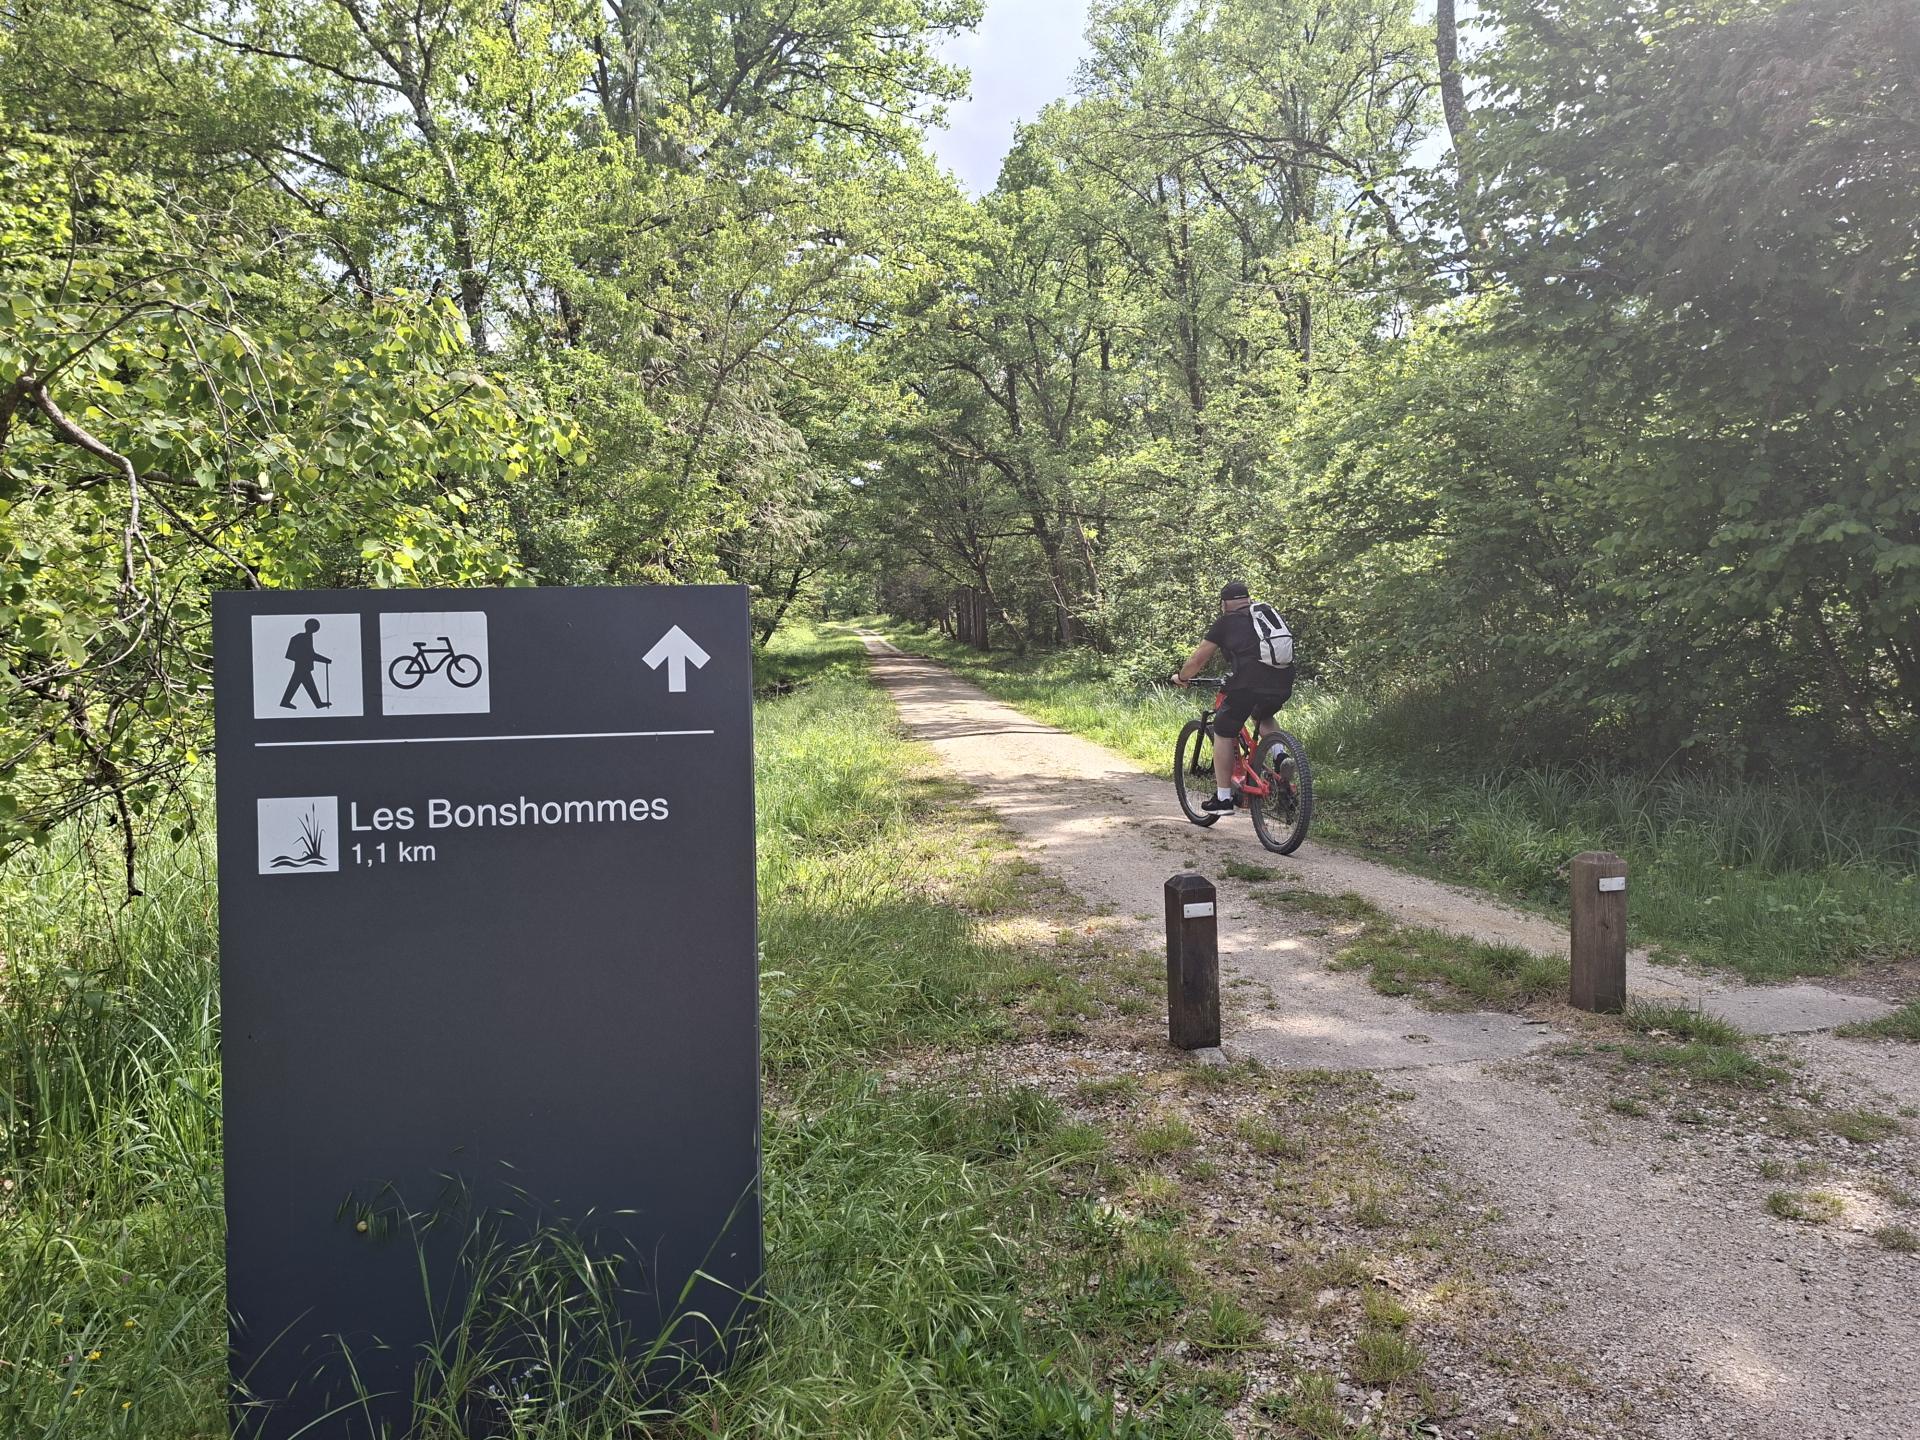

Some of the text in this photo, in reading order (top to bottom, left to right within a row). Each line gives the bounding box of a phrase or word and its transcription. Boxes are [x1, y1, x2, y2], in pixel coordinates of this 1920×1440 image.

[350, 795, 669, 831] Les Bonshommes
[351, 841, 436, 868] 1,1 km
